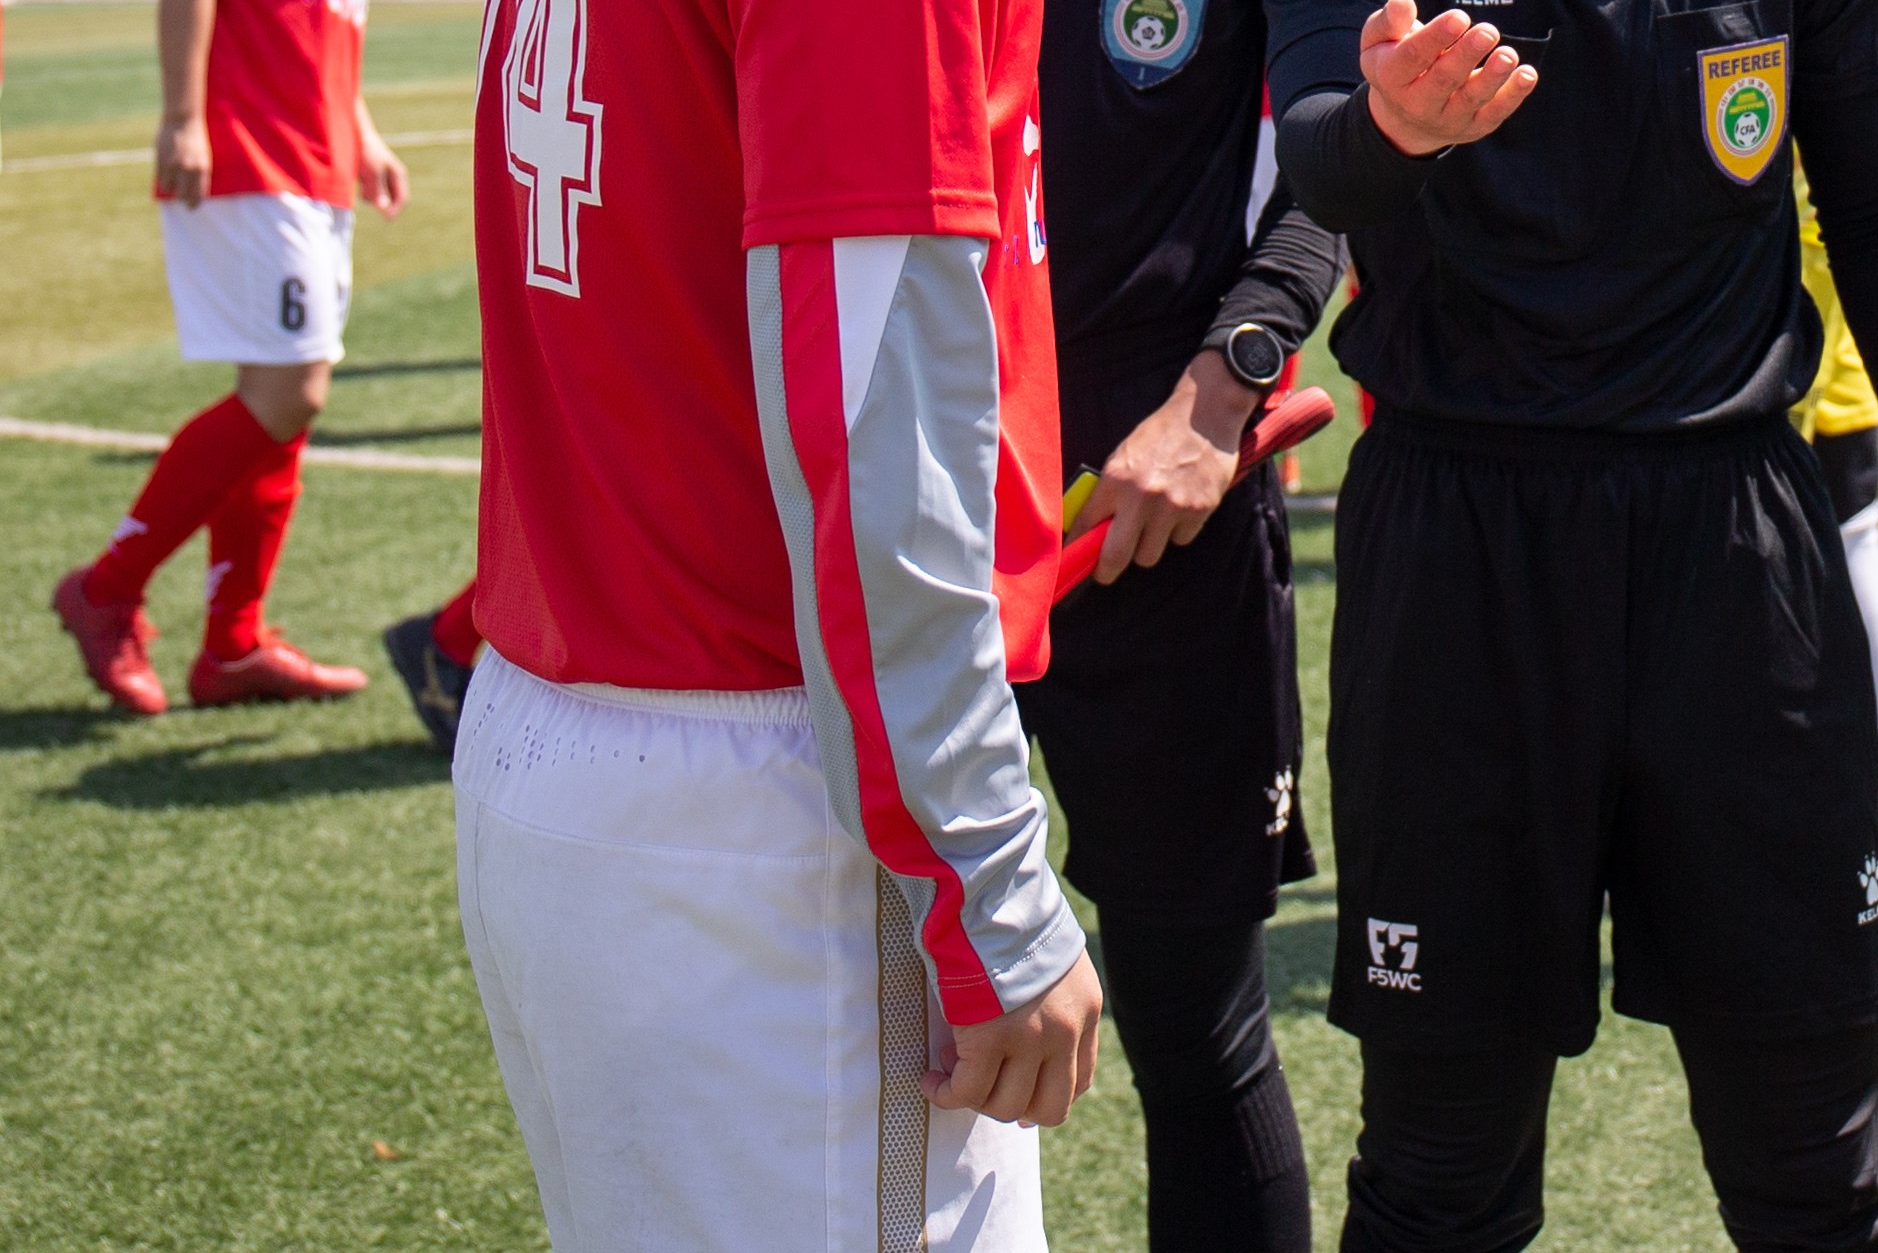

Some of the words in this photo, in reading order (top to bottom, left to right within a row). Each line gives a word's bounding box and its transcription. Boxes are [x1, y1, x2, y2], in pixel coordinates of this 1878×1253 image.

[1708, 50, 1781, 79] REFEREE
[1740, 124, 1756, 136] CFA
[281, 278, 306, 331] 6
[1367, 966, 1422, 992] F5WC
